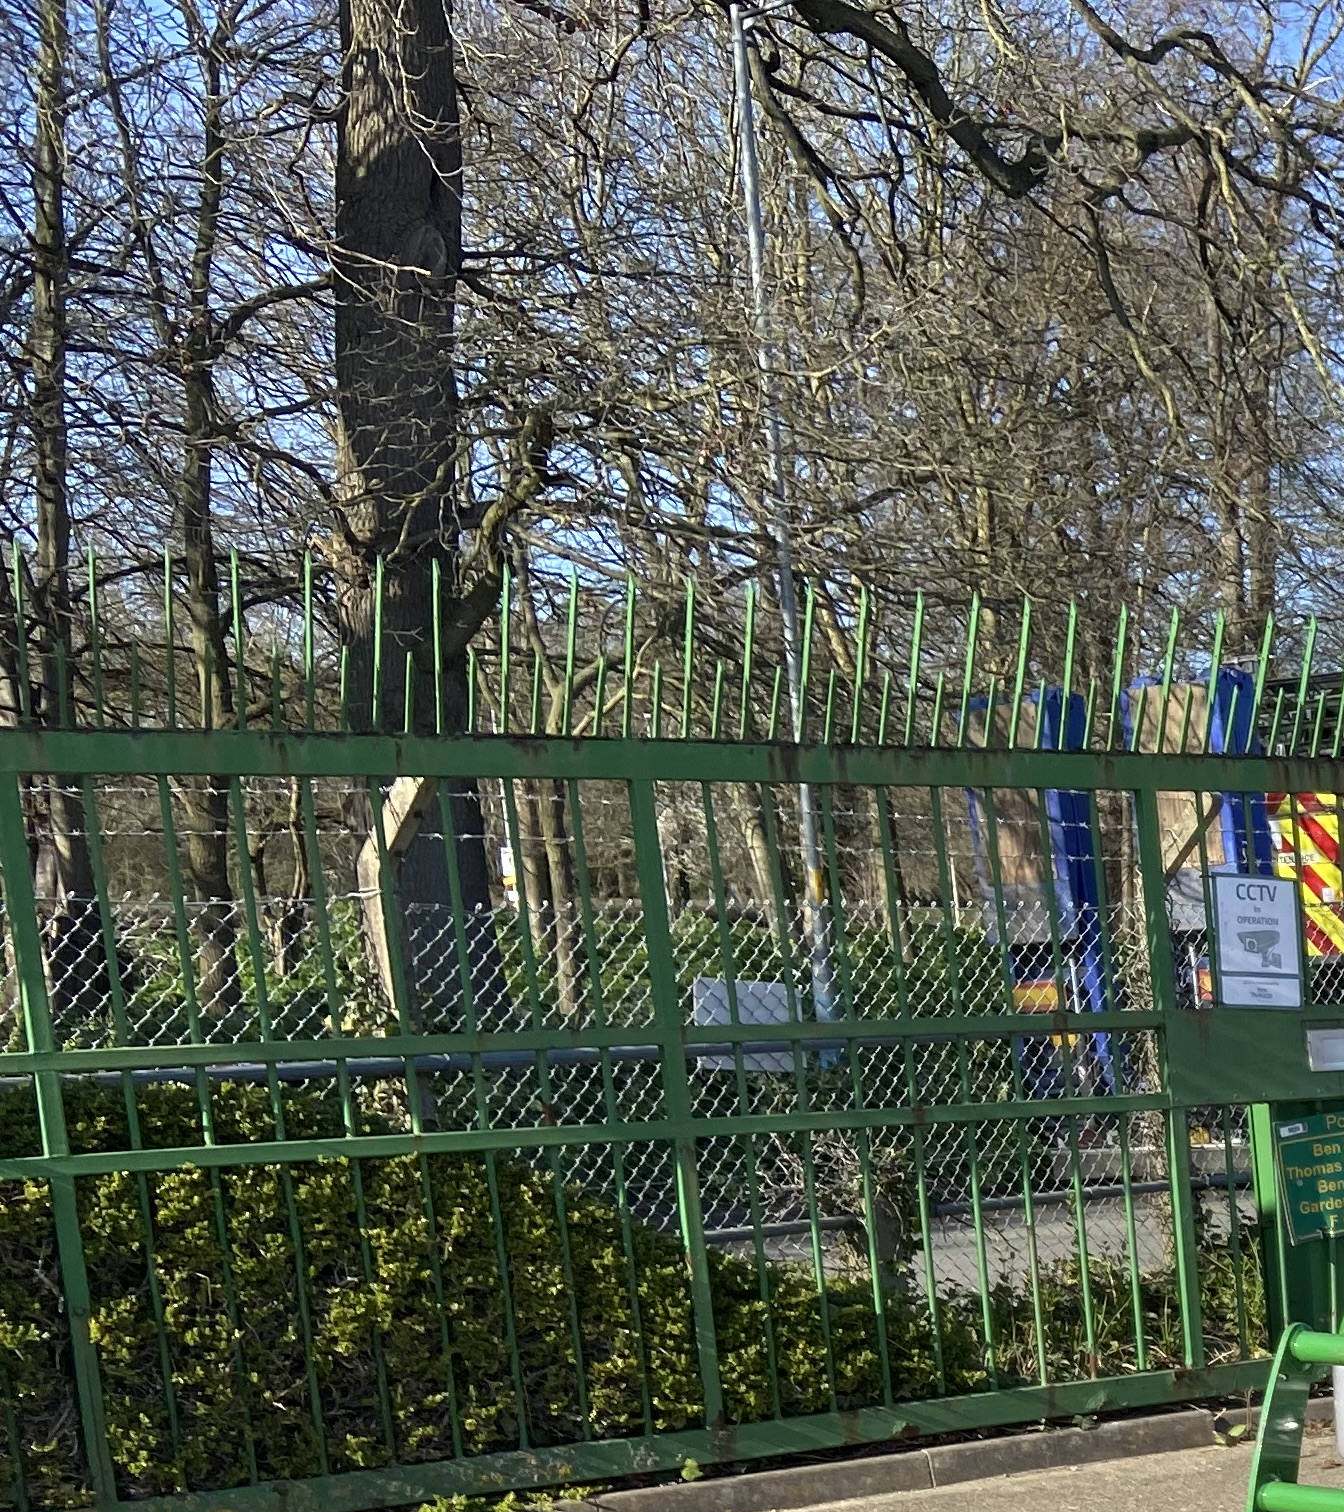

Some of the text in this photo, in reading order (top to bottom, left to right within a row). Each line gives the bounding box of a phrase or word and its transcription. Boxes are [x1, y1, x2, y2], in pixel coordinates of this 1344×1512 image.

[1236, 883, 1277, 902] CCTV
[1237, 916, 1279, 926] OPERATION
[1313, 1143, 1341, 1157] Ben
[1286, 1161, 1342, 1180] Thomas
[1329, 1214, 1338, 1228] F
